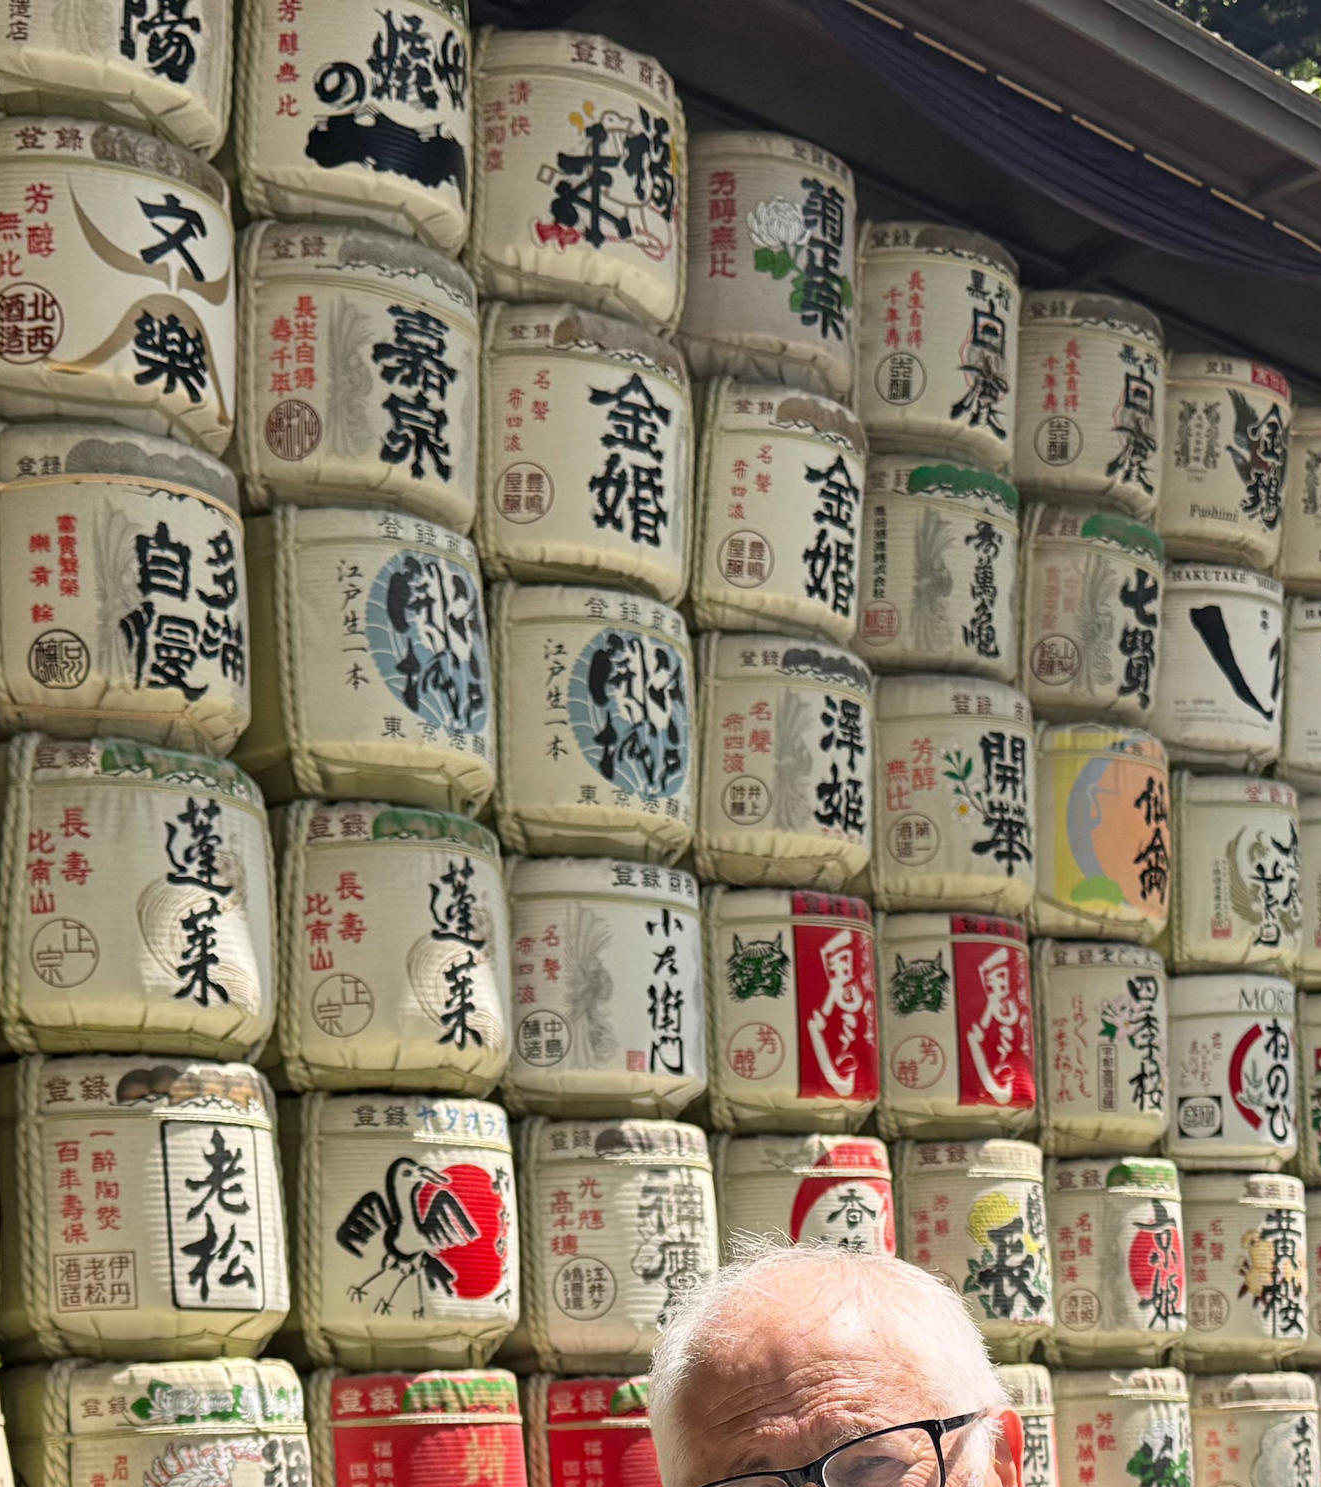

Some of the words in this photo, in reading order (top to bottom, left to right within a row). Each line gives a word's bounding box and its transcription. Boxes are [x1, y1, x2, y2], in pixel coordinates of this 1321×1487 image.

[588, 372, 673, 549] 金婚
[336, 559, 371, 691] 江戸生一本
[544, 637, 569, 761] 江戸生一本
[179, 1128, 257, 1303] 老松
